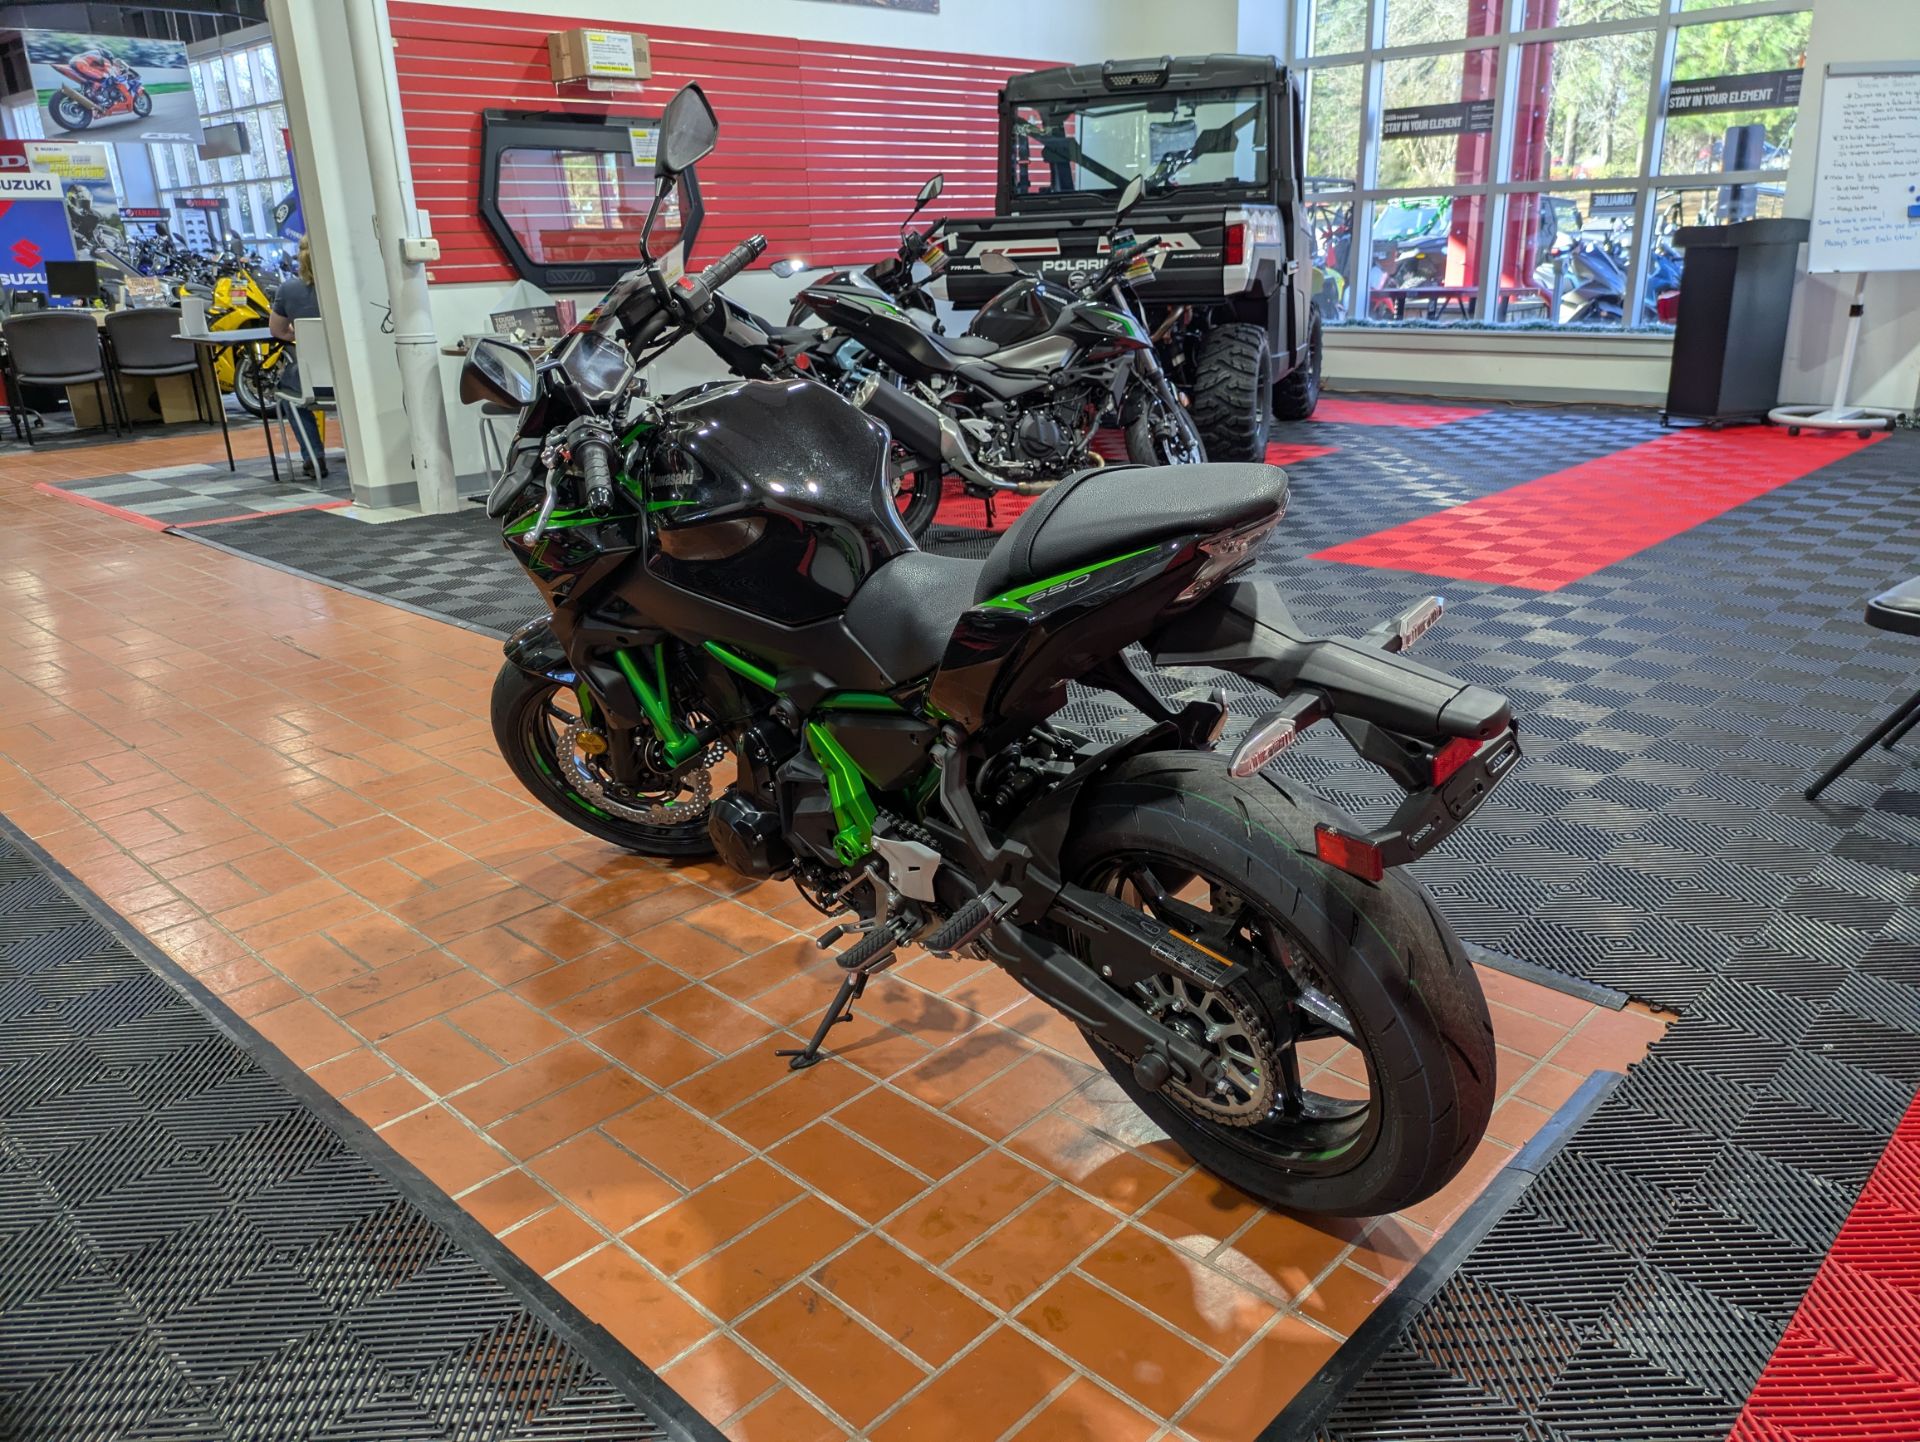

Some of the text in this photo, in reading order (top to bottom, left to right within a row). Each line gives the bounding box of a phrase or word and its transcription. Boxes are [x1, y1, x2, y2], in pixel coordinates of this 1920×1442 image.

[1669, 95, 1691, 109] STAY
[1692, 94, 1703, 107] IN
[1704, 93, 1729, 106] YOUR
[1729, 88, 1773, 103] ELEMENT
[1384, 121, 1400, 134] STAY
[1401, 120, 1410, 132] IN
[1411, 119, 1429, 131] YOUR
[1429, 116, 1463, 130] ELEMENT
[0, 179, 51, 190] UZUKI
[134, 209, 161, 217] YAMAHA
[0, 272, 48, 285] SUZU
[1026, 574, 1091, 603] 650
